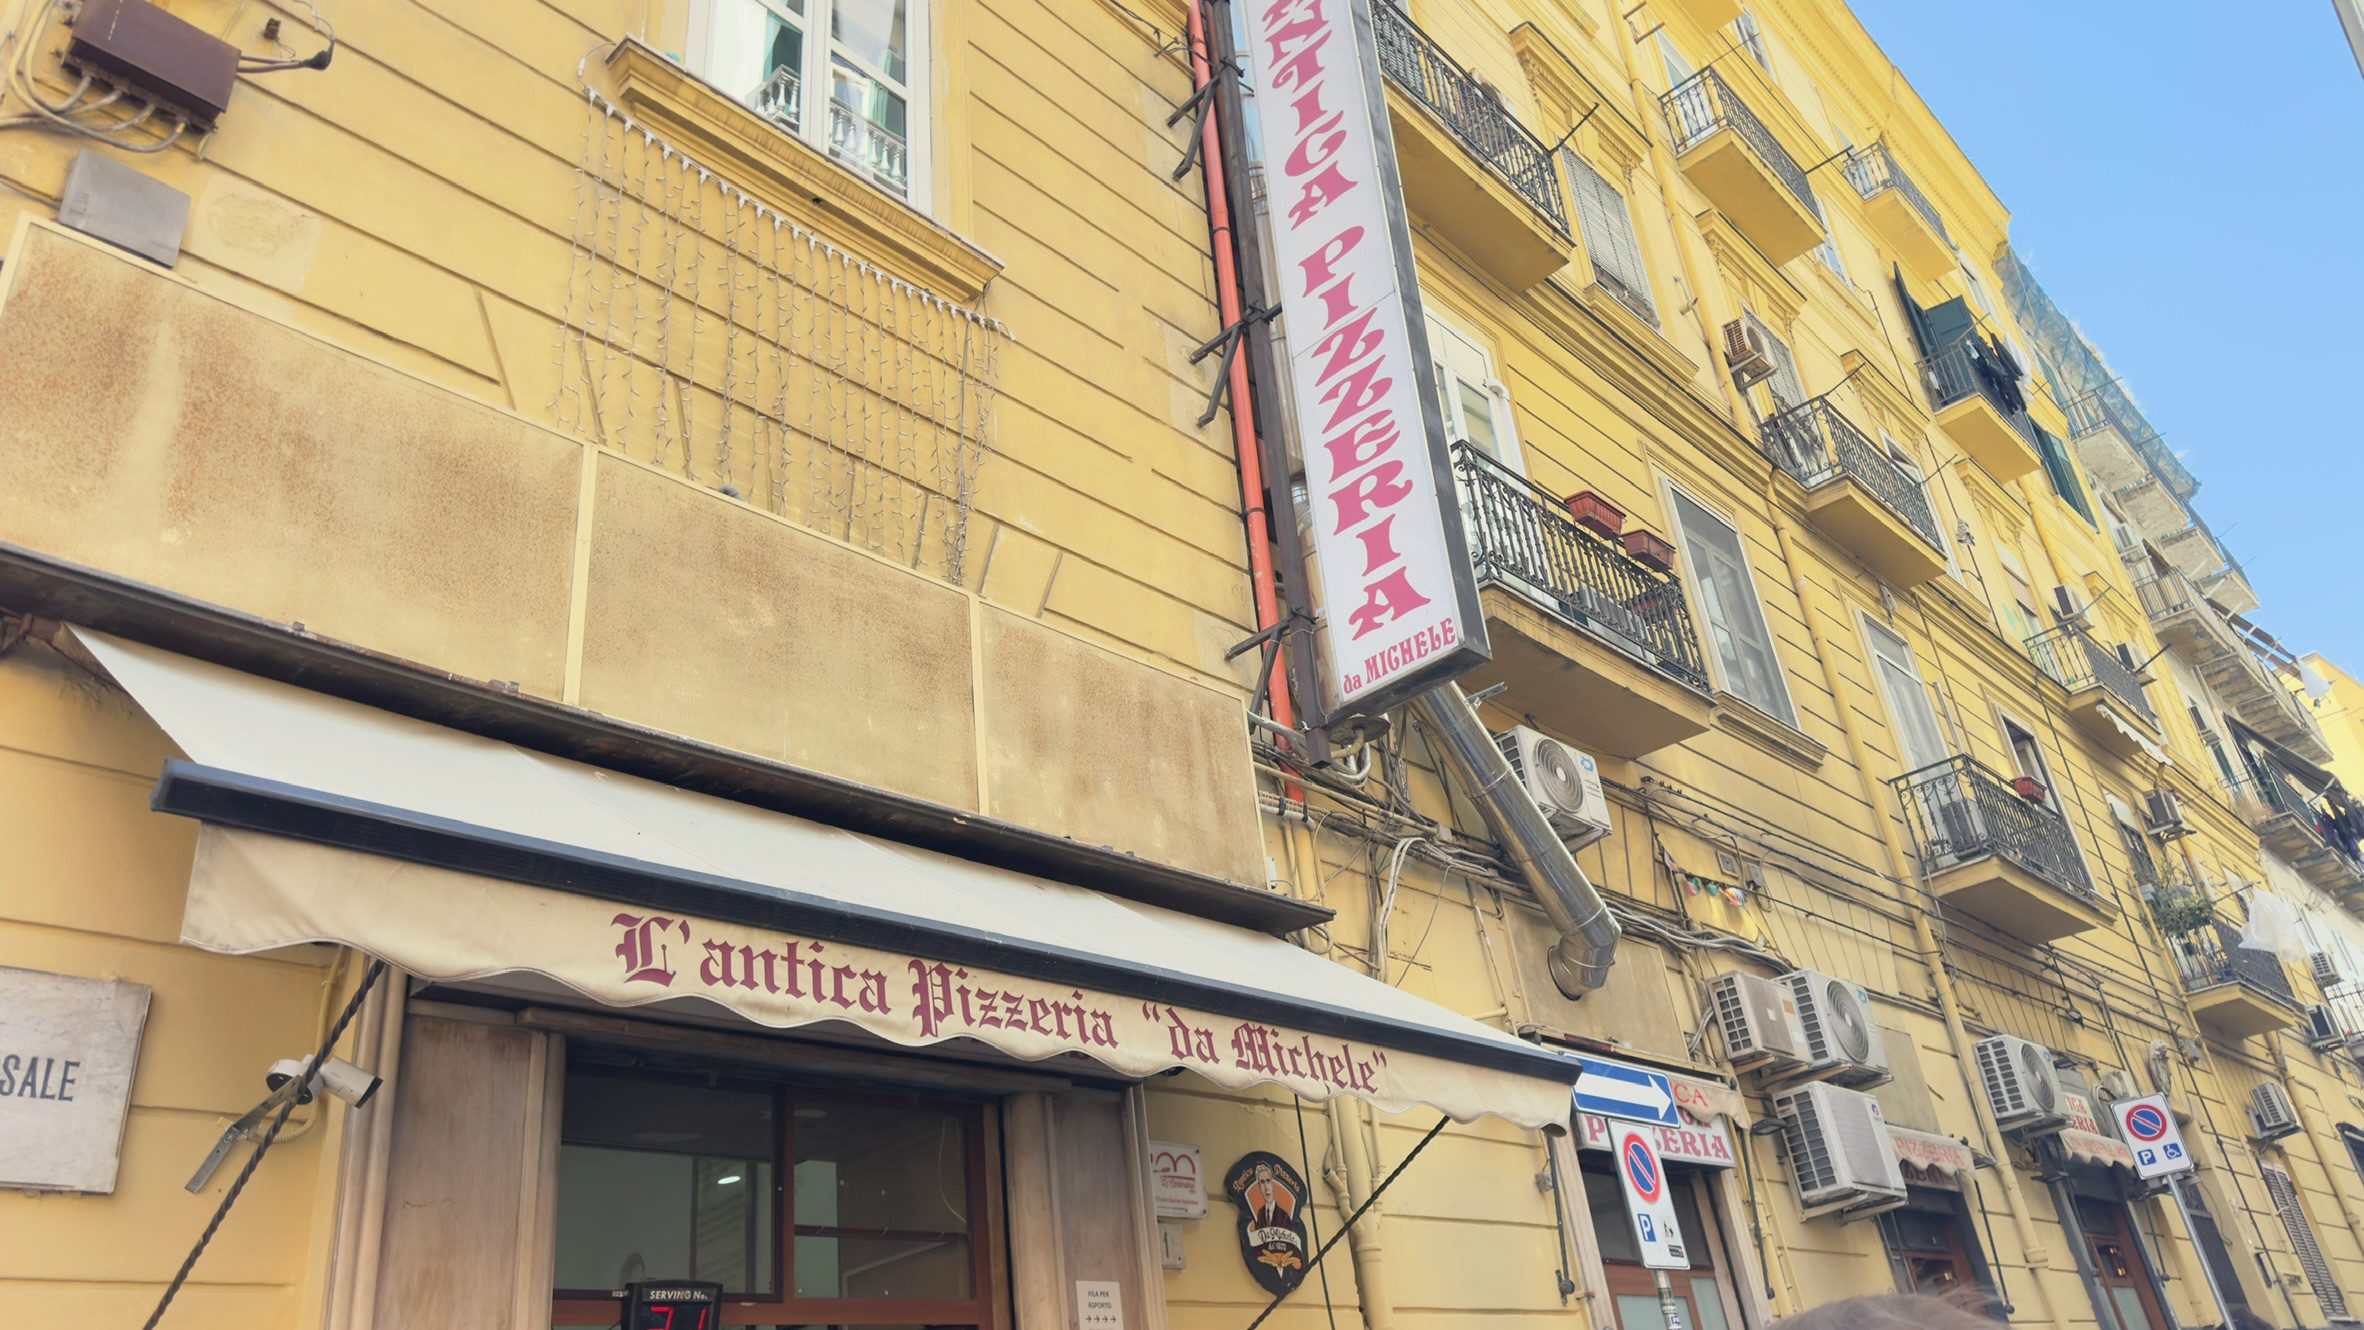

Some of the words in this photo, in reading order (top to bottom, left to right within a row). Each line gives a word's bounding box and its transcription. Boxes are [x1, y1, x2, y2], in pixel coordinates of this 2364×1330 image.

[1298, 225, 1432, 641] PIZZERIA
[1343, 674, 1363, 695] da
[1365, 617, 1457, 684] MICHELE
[611, 912, 892, 1016] L'antica
[907, 958, 1119, 1050] Pizzeria
[2141, 1152, 2153, 1165] P
[1640, 1214, 1651, 1241] P
[649, 1290, 691, 1300] SERVING
[693, 1291, 708, 1300] No.
